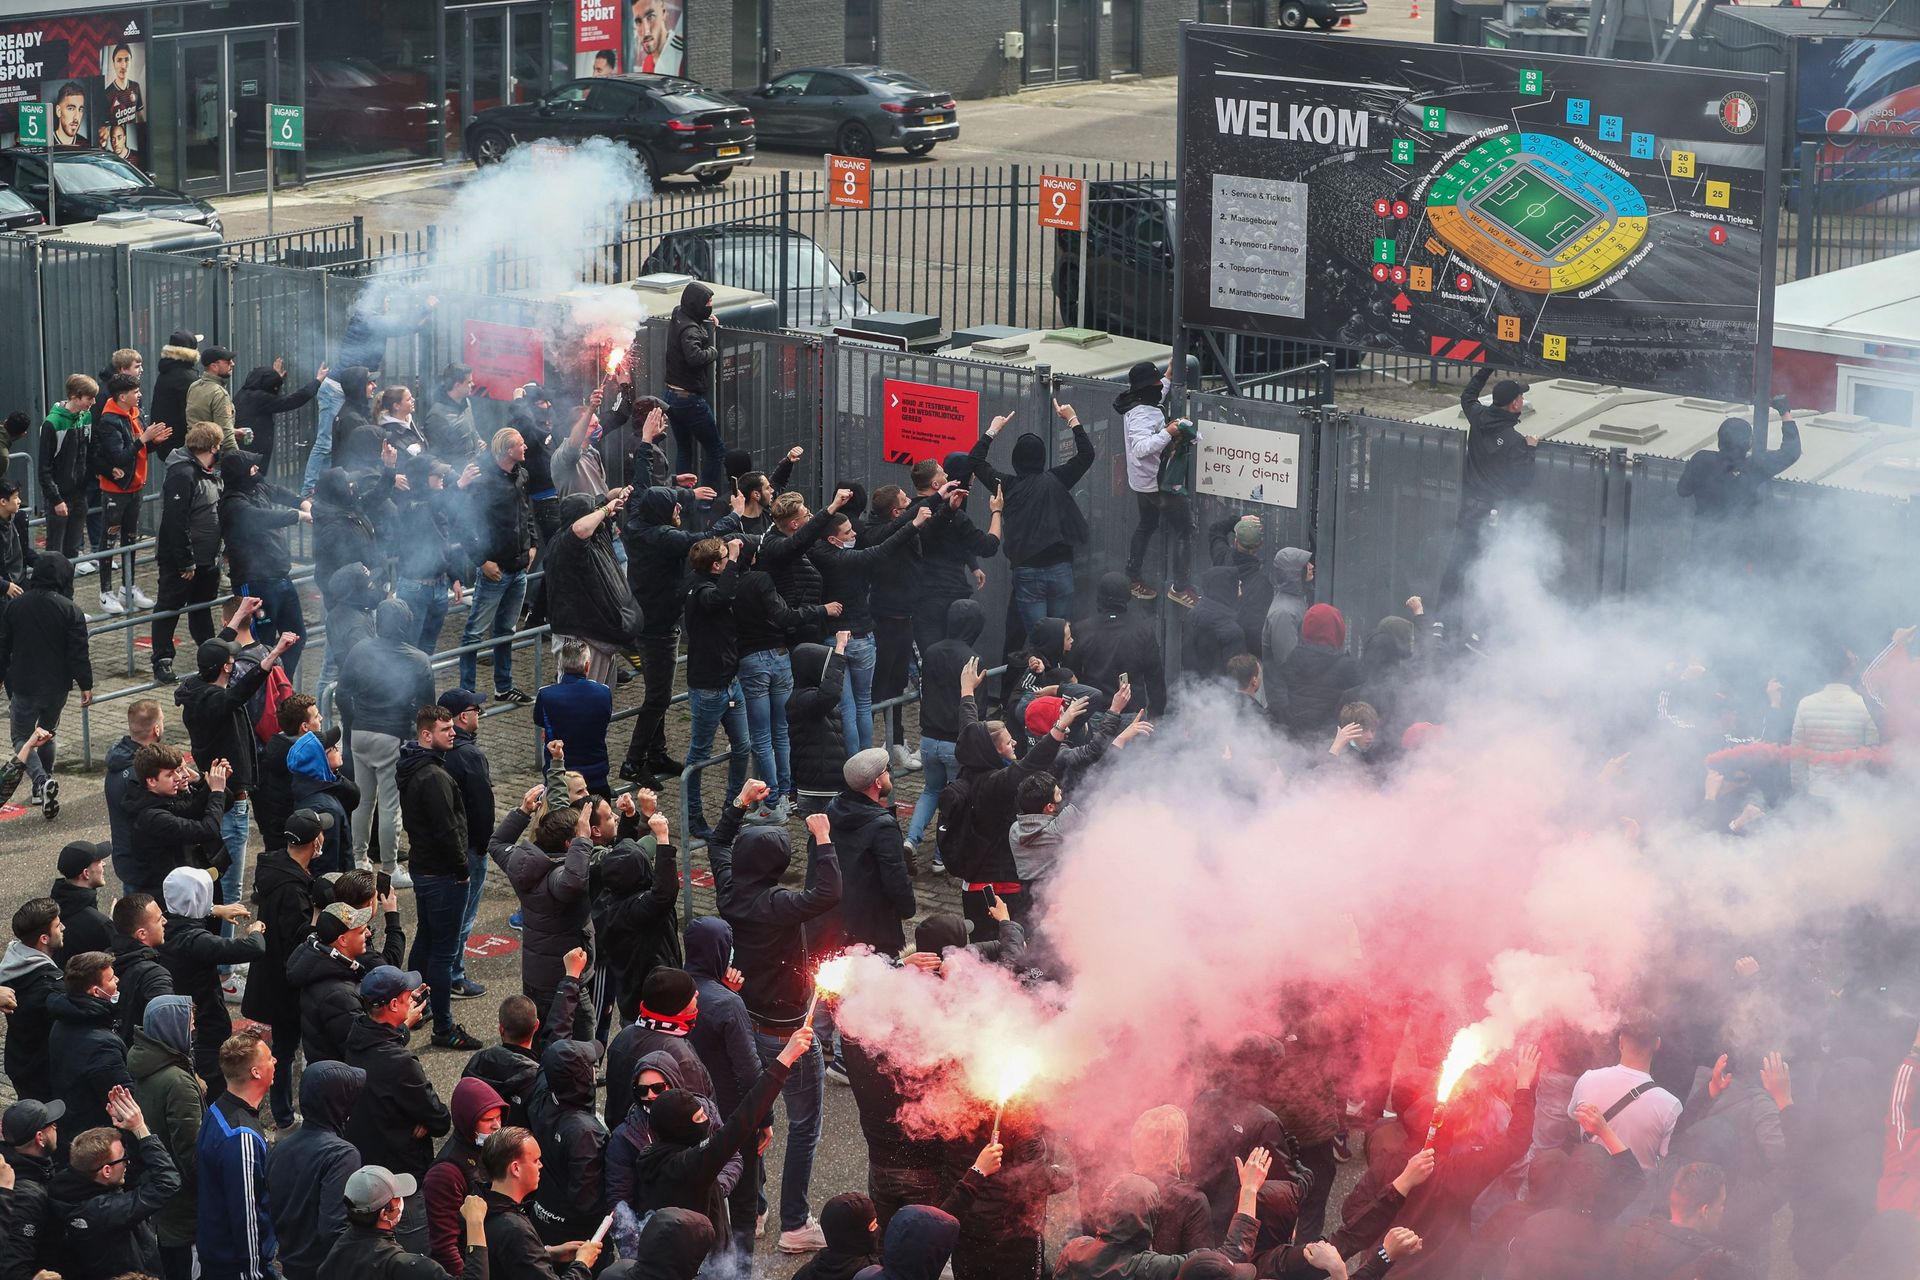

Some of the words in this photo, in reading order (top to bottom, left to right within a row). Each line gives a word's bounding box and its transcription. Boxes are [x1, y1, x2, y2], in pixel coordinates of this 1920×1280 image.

[581, 6, 615, 22] SPORT
[0, 32, 42, 50] READY
[0, 48, 25, 66] FOR
[0, 62, 44, 80] SPORT
[21, 105, 43, 114] INGANG
[274, 108, 299, 117] INGANG
[1869, 108, 1896, 118] pepsi
[28, 116, 38, 136] 5
[1215, 97, 1368, 148] WELKOM
[282, 119, 292, 139] 6
[1528, 135, 1541, 144] DD
[1412, 174, 1432, 201] Willem
[1430, 160, 1444, 174] van
[1441, 135, 1477, 162] Hanegem
[1477, 124, 1508, 139] Tribune
[1573, 136, 1631, 178] Olympiatribune
[834, 159, 866, 170] INGANG
[1459, 159, 1470, 168] GG
[1498, 164, 1508, 172] Y3
[844, 171, 856, 195] 8
[1483, 174, 1493, 184] Y2
[1043, 179, 1076, 191] INGANG
[1468, 186, 1478, 194] Y1
[1574, 186, 1585, 194] Z3
[1231, 190, 1257, 200] Service
[1266, 193, 1292, 203] Tickets
[1052, 192, 1067, 216] 9
[1378, 204, 1386, 212] 5
[1396, 205, 1403, 214] 3
[1231, 214, 1278, 226] Maasgebouw
[1470, 215, 1482, 224] W4
[1690, 210, 1718, 221] Service
[1726, 214, 1753, 225] Tickets
[1488, 226, 1500, 236] W3
[1714, 231, 1720, 240] 1
[1230, 238, 1267, 250] Feyenoord
[1269, 243, 1299, 254] Fanshop
[1504, 238, 1517, 247] W2
[1571, 244, 1582, 252] X3
[1616, 243, 1628, 252] RR
[1522, 249, 1533, 258] W1
[1230, 263, 1289, 277] Topsportcentrum
[1376, 269, 1384, 278] 4
[1394, 270, 1402, 279] 3
[1451, 254, 1498, 289] Maastribune
[1578, 281, 1606, 299] Gerard
[1605, 268, 1629, 287] Meijer
[1628, 242, 1654, 268] Tribune
[1460, 278, 1468, 288] 2
[1560, 277, 1573, 286] UU
[1229, 288, 1290, 302] Marathongebouw
[1441, 292, 1487, 304] Maasgebouw
[1264, 452, 1278, 464] 54
[1239, 465, 1244, 477] /
[1252, 468, 1290, 483] dienst
